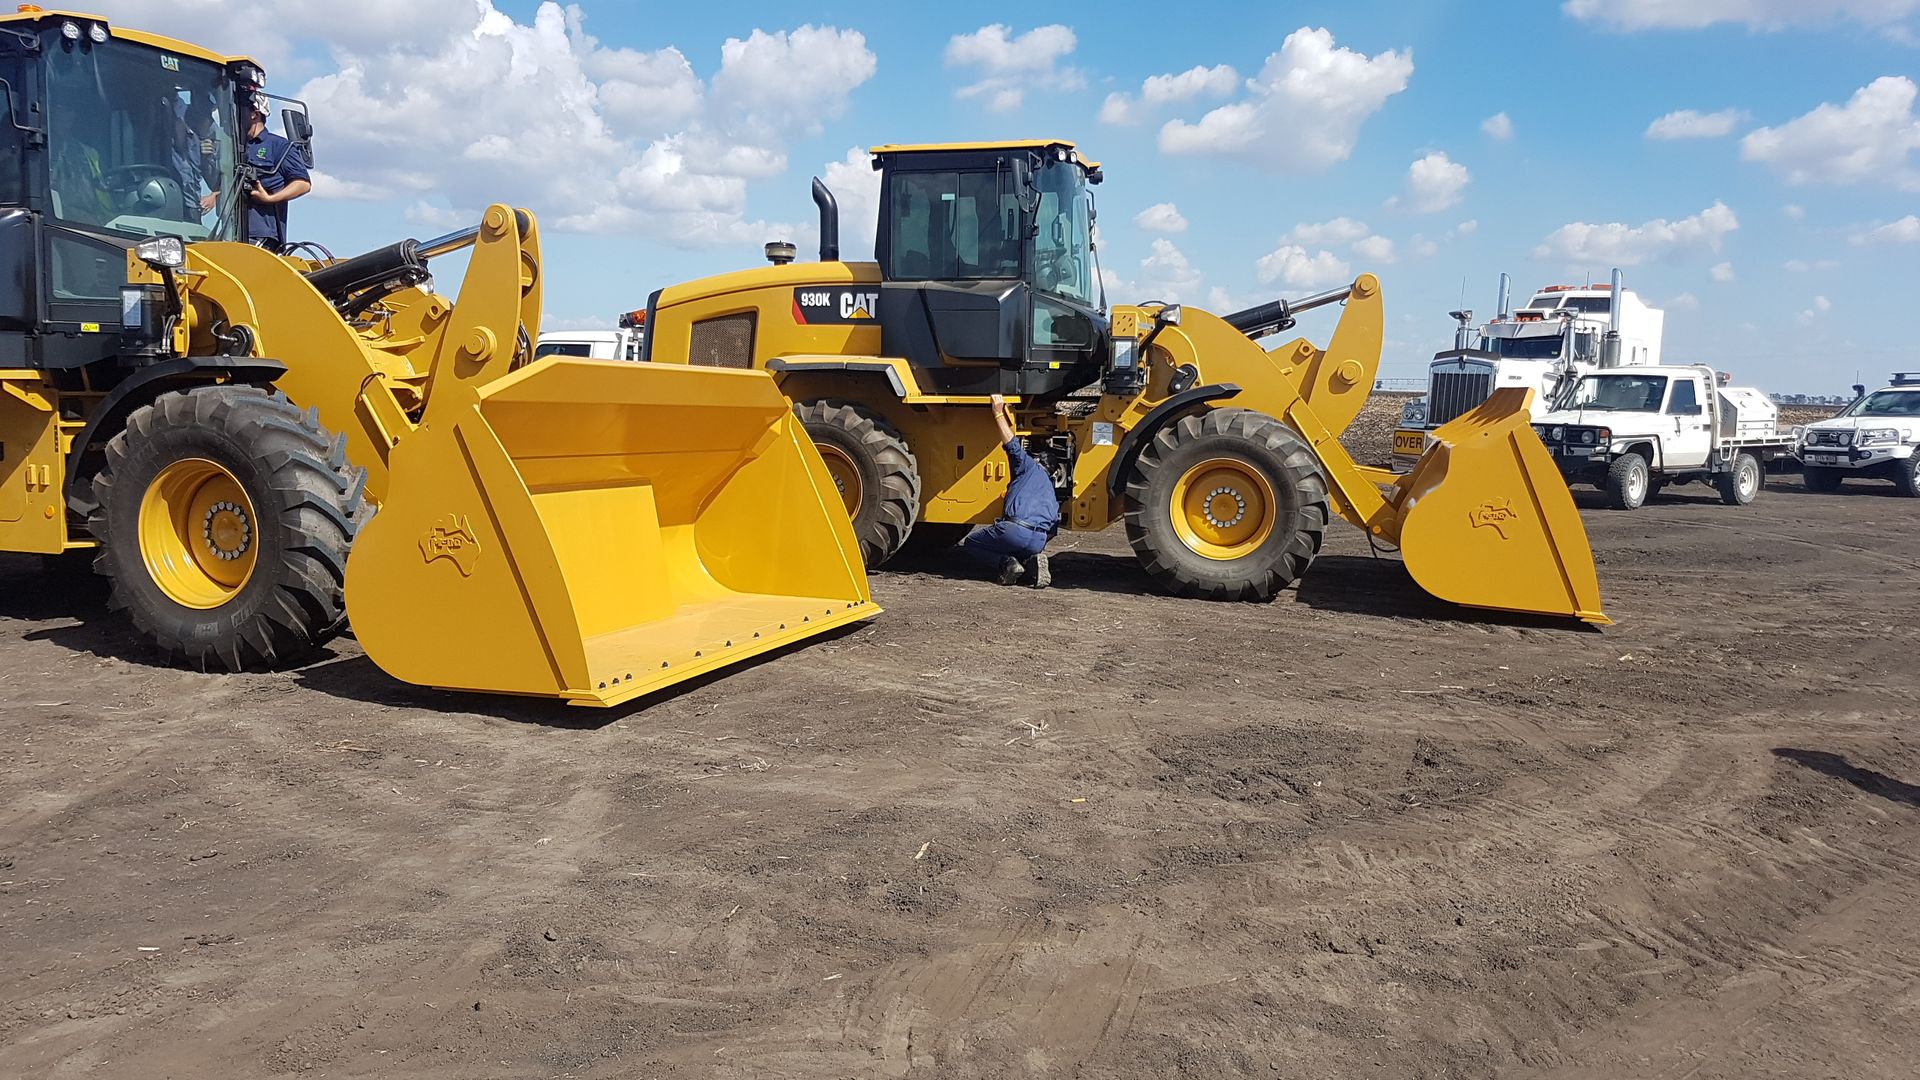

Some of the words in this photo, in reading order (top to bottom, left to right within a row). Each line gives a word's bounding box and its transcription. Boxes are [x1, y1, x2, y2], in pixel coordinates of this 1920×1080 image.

[160, 55, 180, 72] CAT
[801, 292, 831, 307] 930K
[840, 292, 879, 319] CAT
[1395, 436, 1423, 449] OVER
